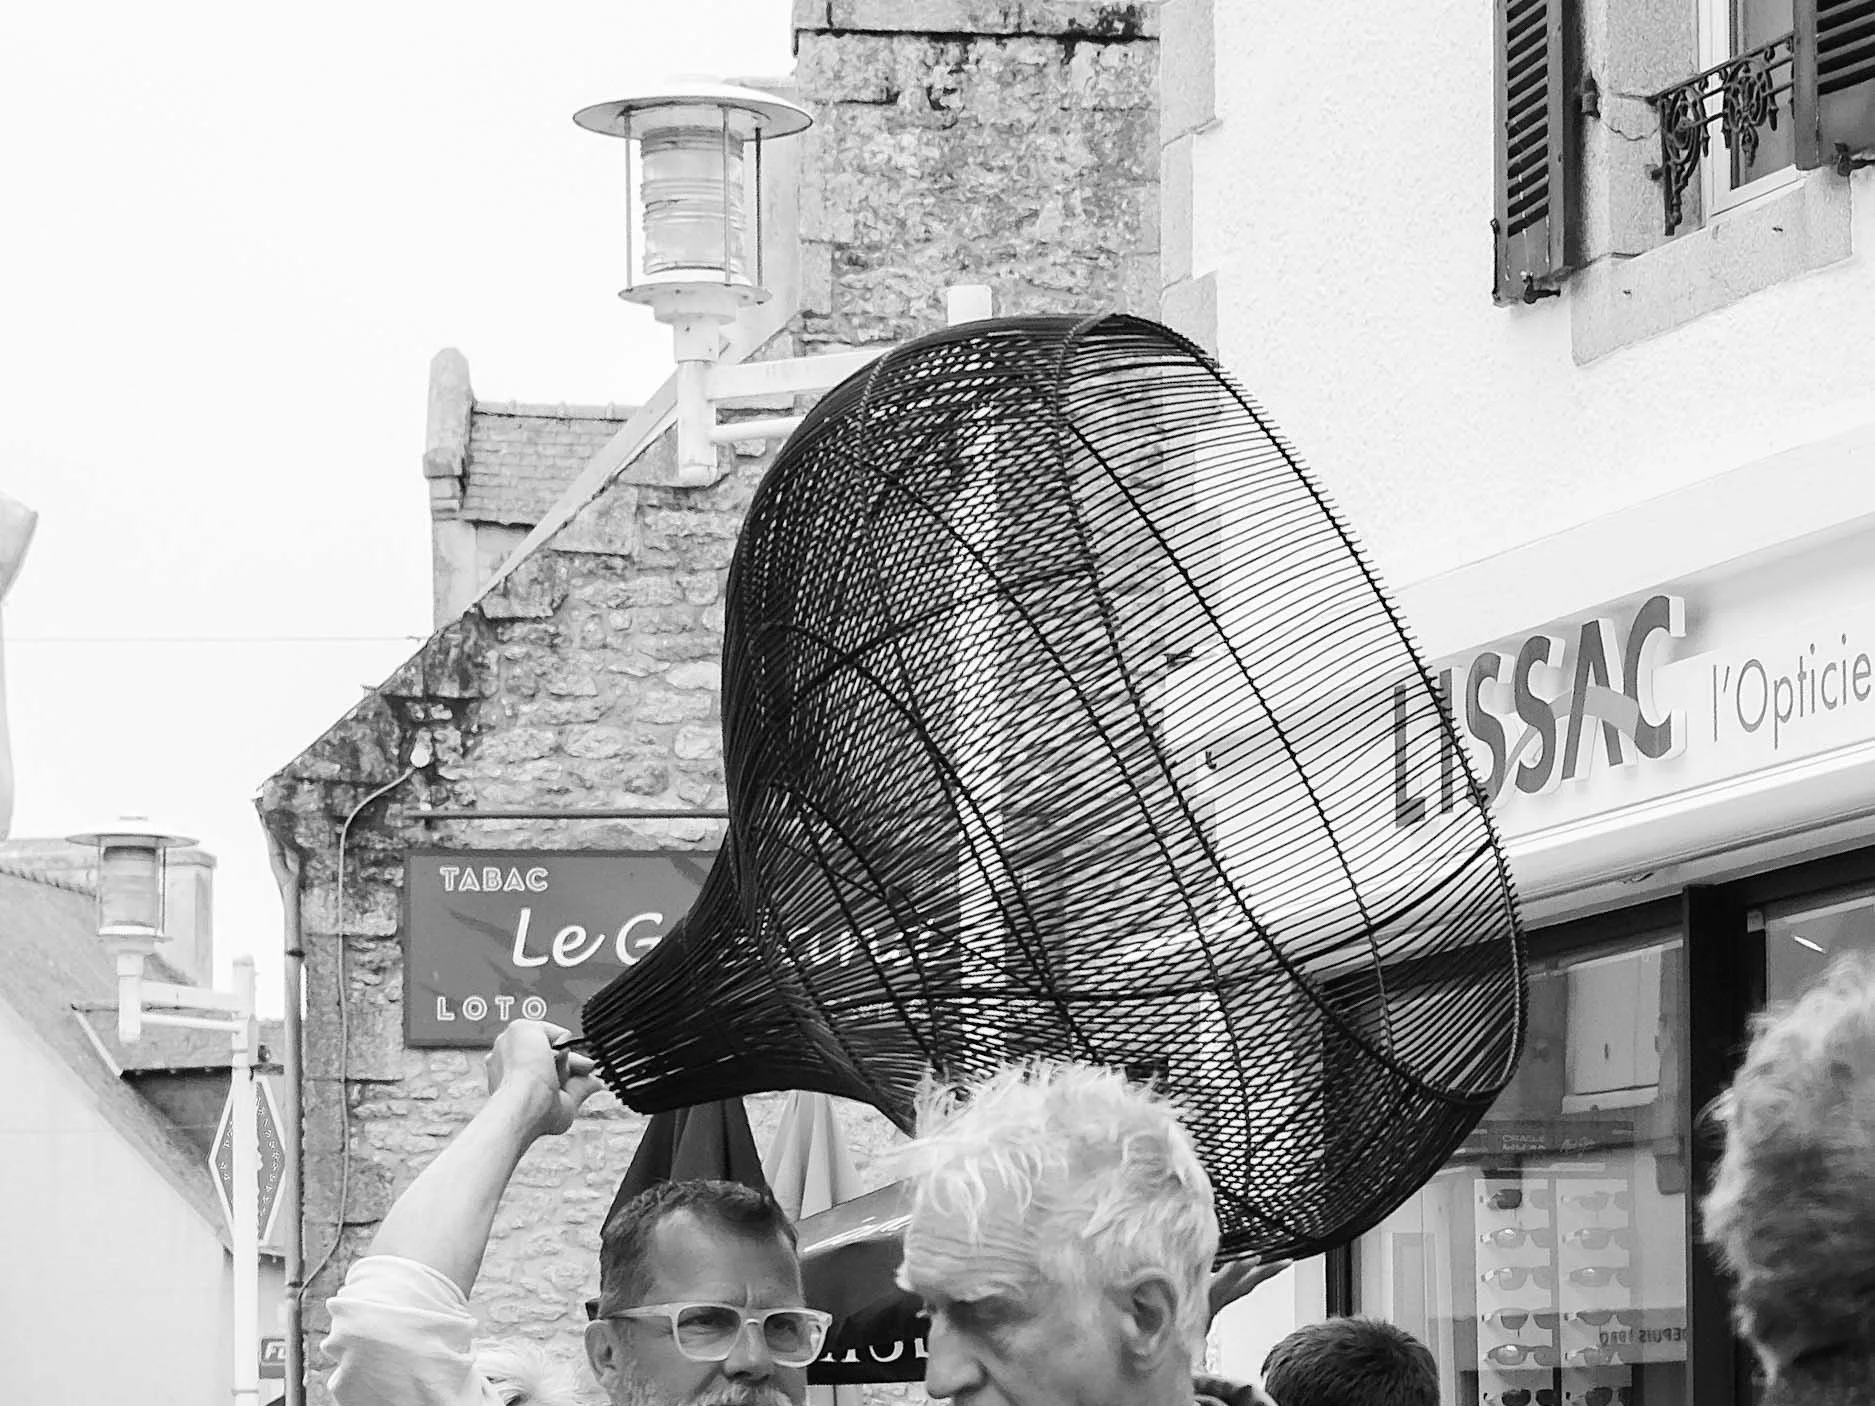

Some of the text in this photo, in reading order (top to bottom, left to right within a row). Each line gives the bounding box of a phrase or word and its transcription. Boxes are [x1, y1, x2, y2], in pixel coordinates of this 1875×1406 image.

[1393, 595, 1680, 829] LISSAC
[1712, 632, 1873, 751] l'Opticie
[439, 866, 550, 893] TABAC
[511, 906, 606, 968] Le
[436, 995, 548, 1021] LOTO
